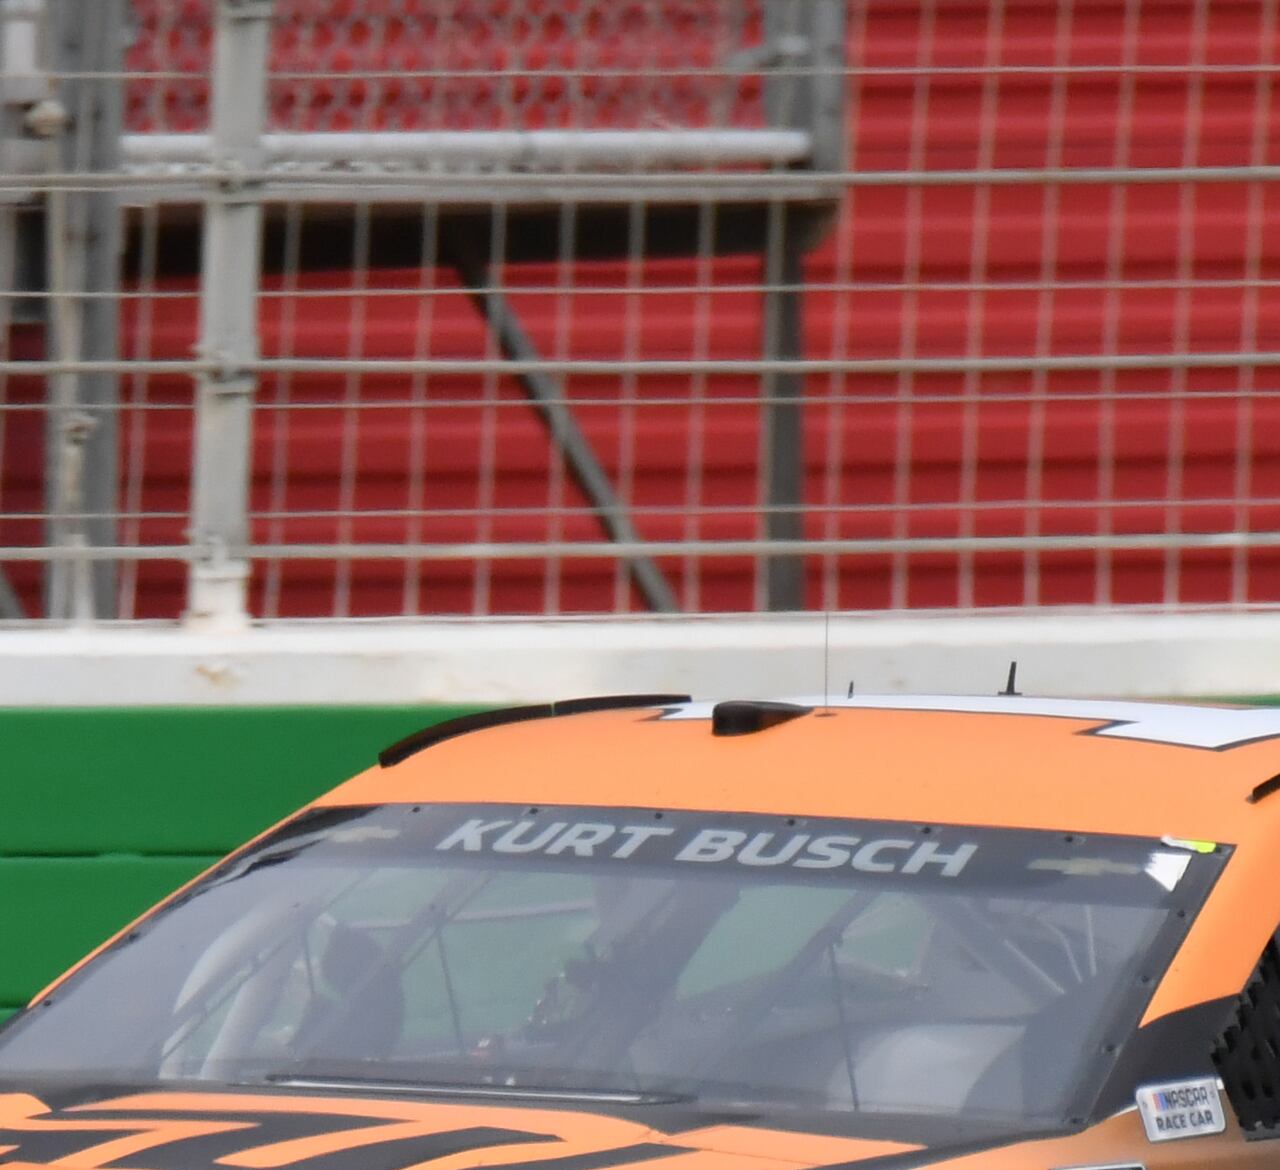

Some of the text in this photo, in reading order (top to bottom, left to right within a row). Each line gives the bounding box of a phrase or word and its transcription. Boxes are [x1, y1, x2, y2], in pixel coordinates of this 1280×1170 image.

[436, 817, 979, 878] KURT BUSCH
[1163, 1086, 1210, 1110] NASCAR
[1155, 1110, 1215, 1132] RACE CAR
